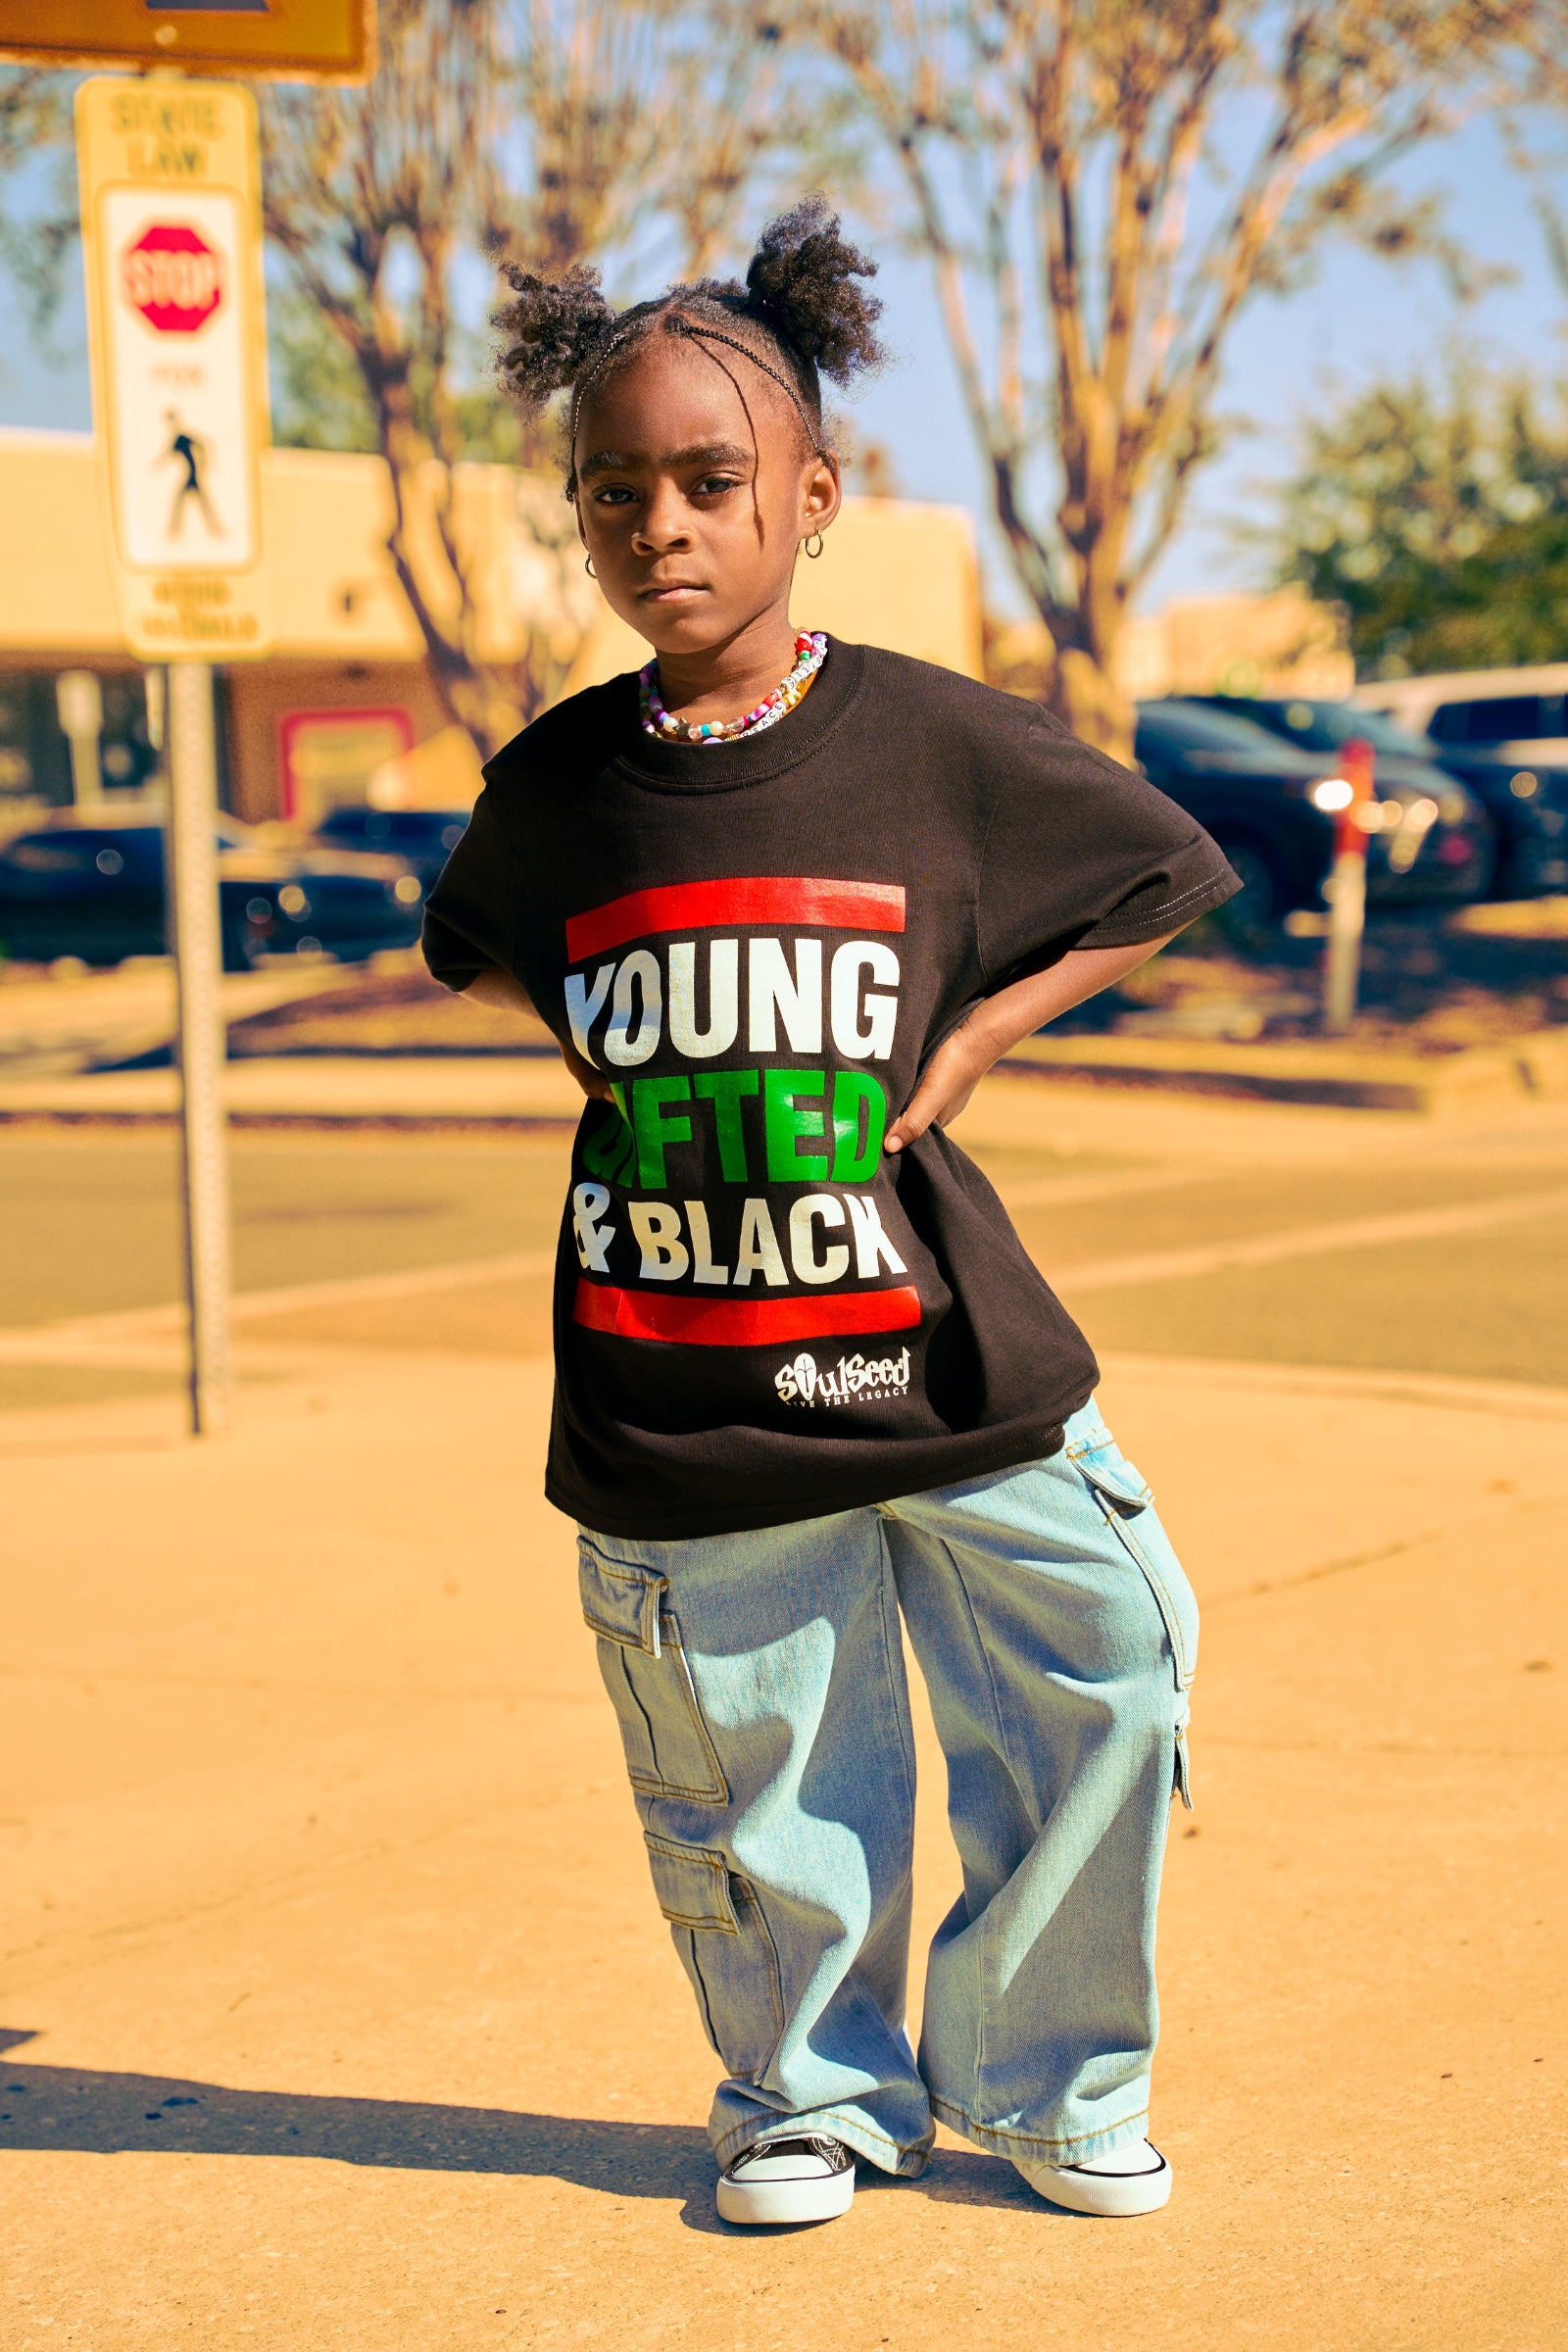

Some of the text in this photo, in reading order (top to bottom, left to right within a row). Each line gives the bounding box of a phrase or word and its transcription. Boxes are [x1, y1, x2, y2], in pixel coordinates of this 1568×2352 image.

[127, 138, 209, 177] LAW
[126, 249, 220, 310] STOP
[564, 937, 902, 1070] YOUNG
[572, 1182, 908, 1287] & BLACK
[824, 1395, 851, 1407] THE
[858, 1386, 908, 1402] LEGACY
